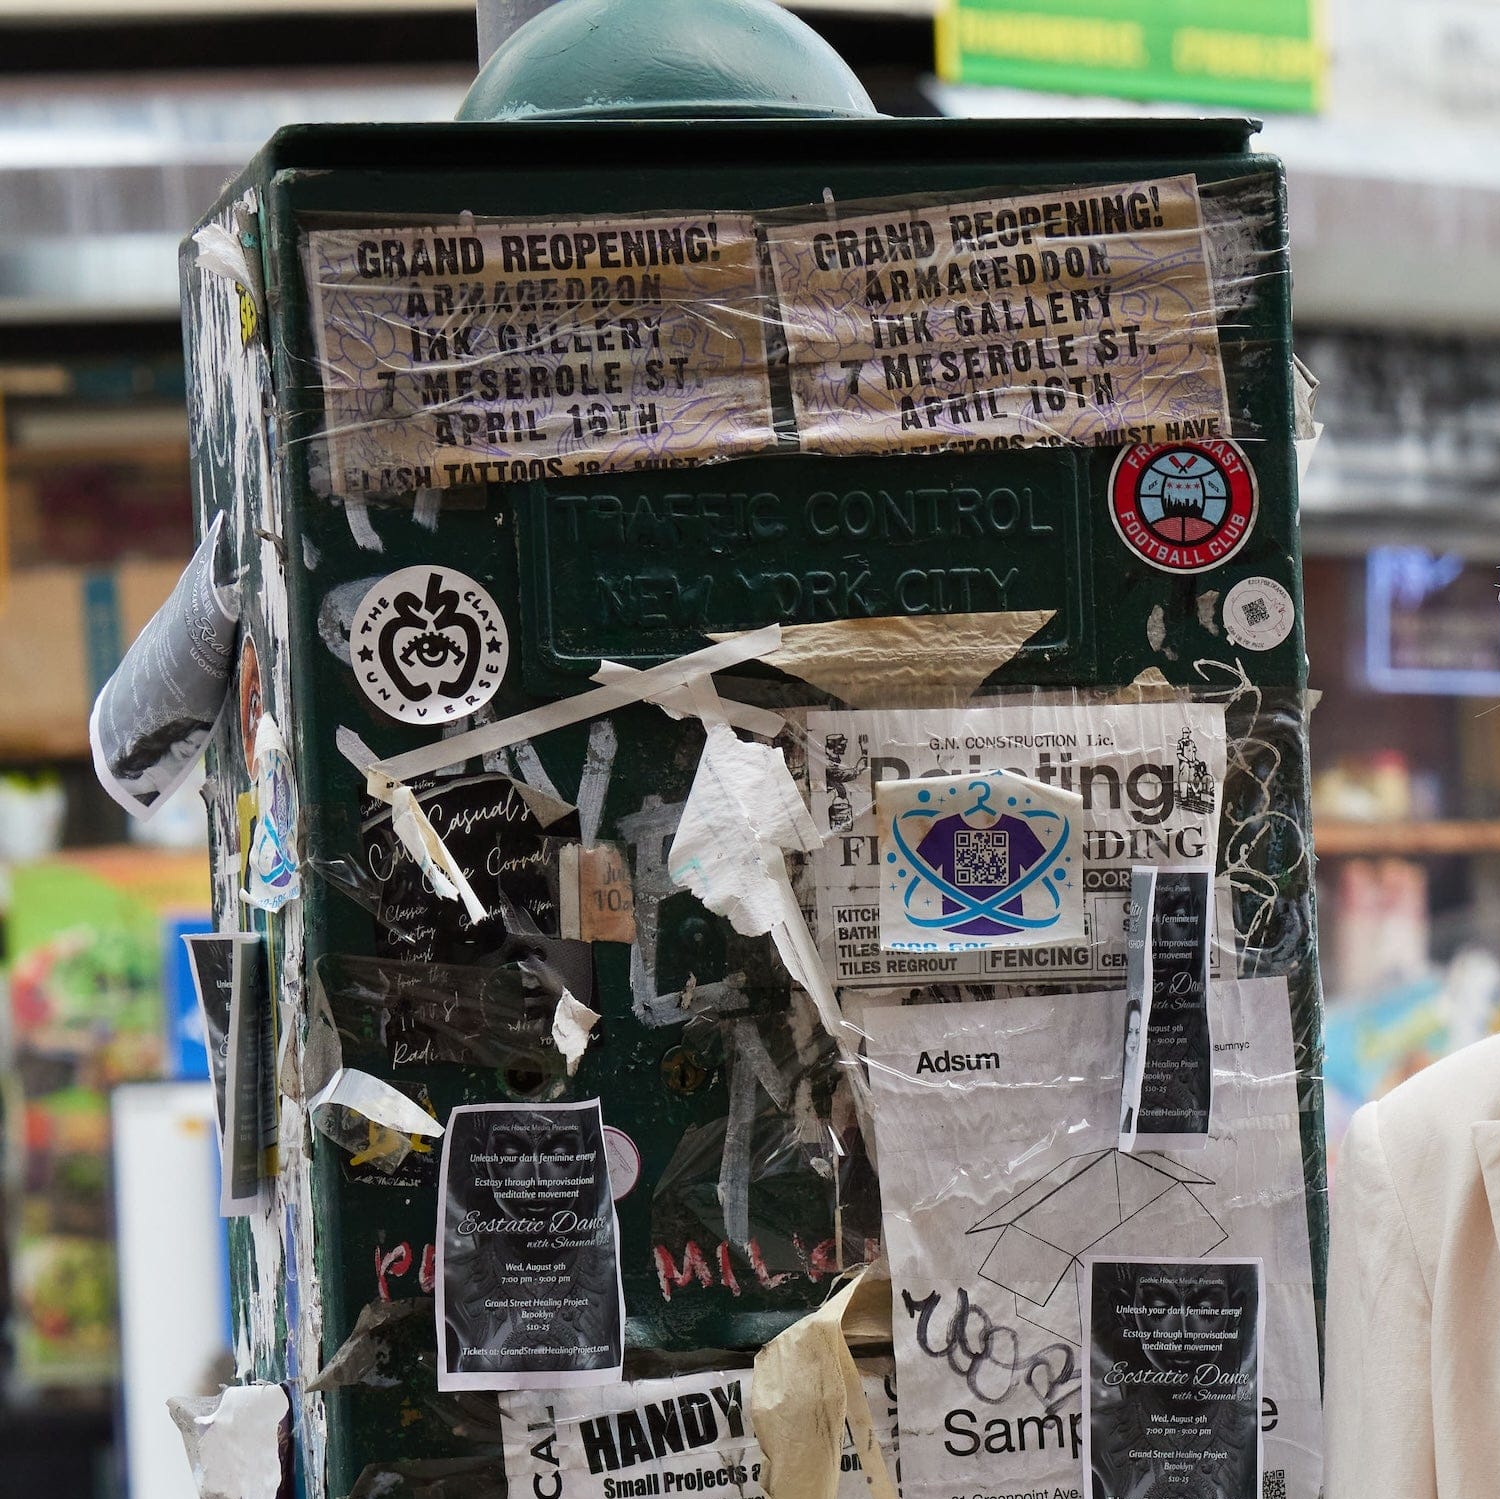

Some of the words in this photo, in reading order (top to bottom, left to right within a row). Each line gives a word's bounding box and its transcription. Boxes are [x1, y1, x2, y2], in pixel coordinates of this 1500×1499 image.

[814, 219, 935, 272] GRAND
[949, 187, 1164, 254] REOPENING!
[357, 235, 484, 279] GRAND
[502, 222, 721, 273] REOPENING!
[865, 244, 1111, 307] ARMAGEDDON
[407, 273, 663, 318] ARMAGEDDON
[870, 311, 934, 350] INK
[955, 285, 1113, 337] GALLERY
[411, 325, 473, 361] INK
[498, 316, 663, 355] GALLERY
[840, 363, 860, 395] 7
[886, 336, 1078, 391] MESEROLE
[1099, 324, 1156, 361] ST.
[378, 371, 397, 409] 7
[424, 362, 623, 405] MESEROLE
[901, 385, 1008, 432] APRIL
[1030, 373, 1115, 414] 16TH
[436, 411, 547, 447] APRIL
[1165, 416, 1221, 441] HAVE
[444, 457, 564, 487] TATTOOS
[553, 491, 788, 545] TRAFFIC
[804, 487, 1055, 538] CONTROL
[1120, 510, 1206, 566] FOOTBALL
[1208, 513, 1247, 557] CLUB
[896, 566, 1020, 614] CITY
[360, 596, 390, 636] THE
[463, 590, 499, 633] CLAY
[366, 663, 500, 718] UNIVERSE
[929, 737, 960, 751] G.N.
[965, 734, 1078, 750] CONSTRUCTION
[1086, 734, 1114, 748] Lic.
[837, 907, 881, 923] KITCH
[839, 943, 880, 958] TILES
[990, 947, 1090, 970] FENCING
[840, 961, 881, 975] TILES
[886, 957, 958, 975] REGROUT
[916, 1049, 1001, 1075] Adsum
[470, 1153, 498, 1163] Unleash
[499, 1155, 518, 1164] your
[519, 1152, 537, 1162] dark
[537, 1153, 574, 1164] feminine
[474, 1177, 503, 1188] Ecstasy
[504, 1177, 535, 1188] through
[494, 1189, 537, 1199] meditative
[538, 1189, 579, 1198] movement
[457, 1209, 545, 1235] Ecstatic
[549, 1209, 607, 1234] Dance
[501, 1276, 518, 1284] 7:00
[519, 1276, 533, 1285] pm
[538, 1275, 557, 1285] 9:00
[558, 1276, 571, 1285] pm
[525, 1262, 551, 1273] August
[553, 1262, 567, 1273] 9th
[484, 1299, 508, 1308] Grand
[509, 1298, 532, 1308] Street
[532, 1298, 562, 1309] Healing
[563, 1297, 589, 1309] Project
[521, 1310, 554, 1320] Brooklyn
[1116, 1305, 1148, 1315] Unleash
[1149, 1307, 1167, 1317] your
[1167, 1305, 1185, 1315] dark
[1185, 1305, 1220, 1317] feminine
[1123, 1328, 1151, 1341] Ecstasy
[1152, 1328, 1183, 1341] through
[1142, 1341, 1183, 1351] meditative
[1183, 1343, 1223, 1352] movement
[462, 1347, 488, 1356] Tickets
[1103, 1360, 1189, 1386] Ecstatic
[1193, 1363, 1250, 1387] Dance
[579, 1380, 746, 1474] HANDY
[1146, 1427, 1163, 1436] 7:00
[1164, 1427, 1176, 1436] pm
[1181, 1427, 1198, 1437] 9:00
[1199, 1427, 1212, 1437] pm
[1169, 1414, 1194, 1425] August
[1194, 1414, 1208, 1425] 9th
[1128, 1450, 1152, 1459] Grand
[1152, 1450, 1174, 1459] Street
[1175, 1450, 1202, 1460] Healing
[1203, 1450, 1228, 1461] Project
[603, 1474, 659, 1499] Small
[664, 1464, 748, 1493] Projects
